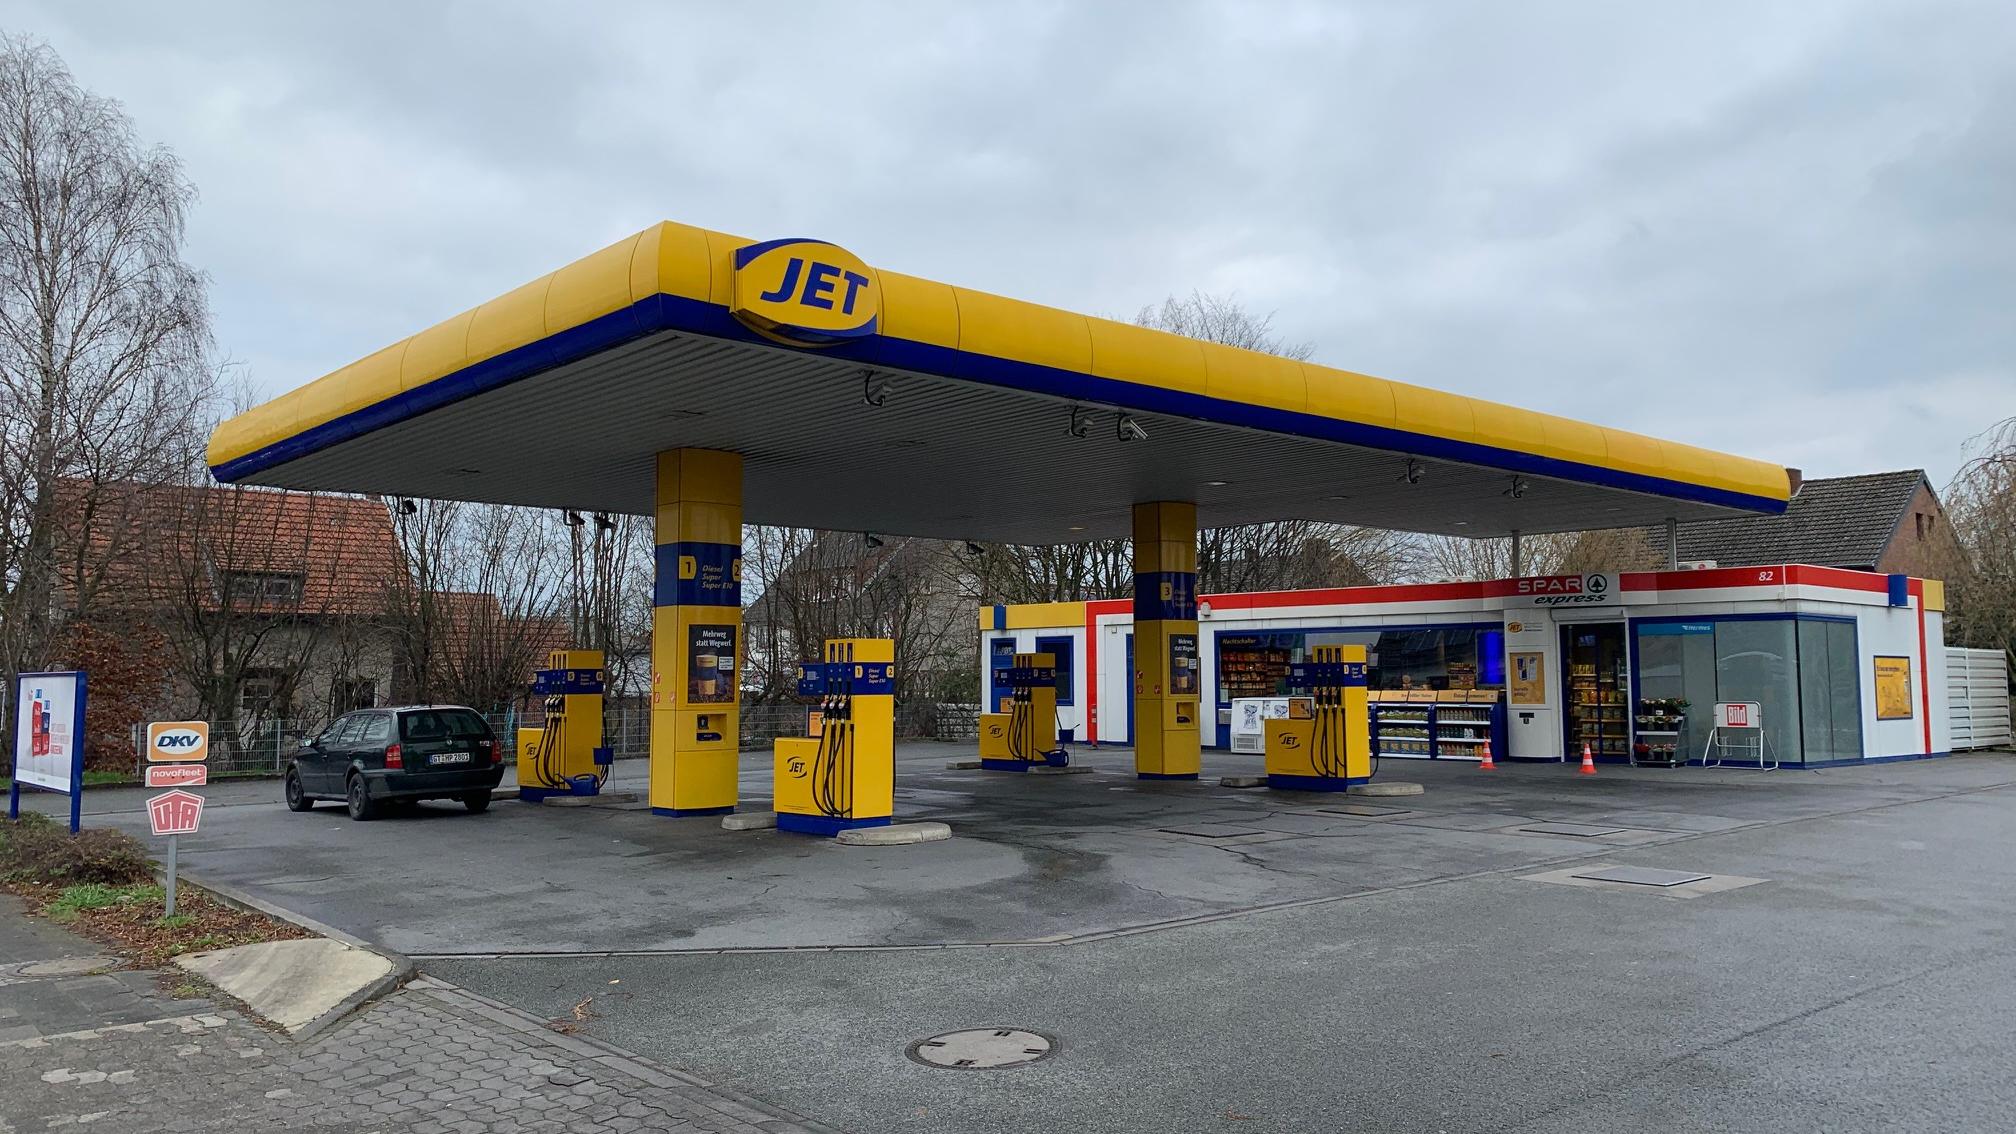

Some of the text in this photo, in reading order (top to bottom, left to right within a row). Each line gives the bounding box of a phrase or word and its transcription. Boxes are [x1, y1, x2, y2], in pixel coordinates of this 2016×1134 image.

[760, 257, 869, 316] JET
[685, 561, 691, 573] 1
[702, 564, 724, 573] Diesel
[734, 564, 740, 576] 2
[702, 573, 722, 582] Super
[1758, 571, 1774, 582] 82
[702, 581, 734, 590] Super E10
[1518, 577, 1581, 593] SPAR
[1164, 586, 1170, 596] 3
[1534, 594, 1608, 605] express
[702, 629, 727, 639] Mehrweg
[695, 639, 709, 647] statt
[1728, 706, 1747, 725] Bild
[990, 727, 1002, 736] JET
[157, 735, 201, 747] DKV
[1281, 736, 1298, 745] JET
[527, 746, 537, 756] JET
[789, 761, 806, 773] JET
[152, 768, 204, 779] novofleet
[153, 793, 199, 831] UTA
